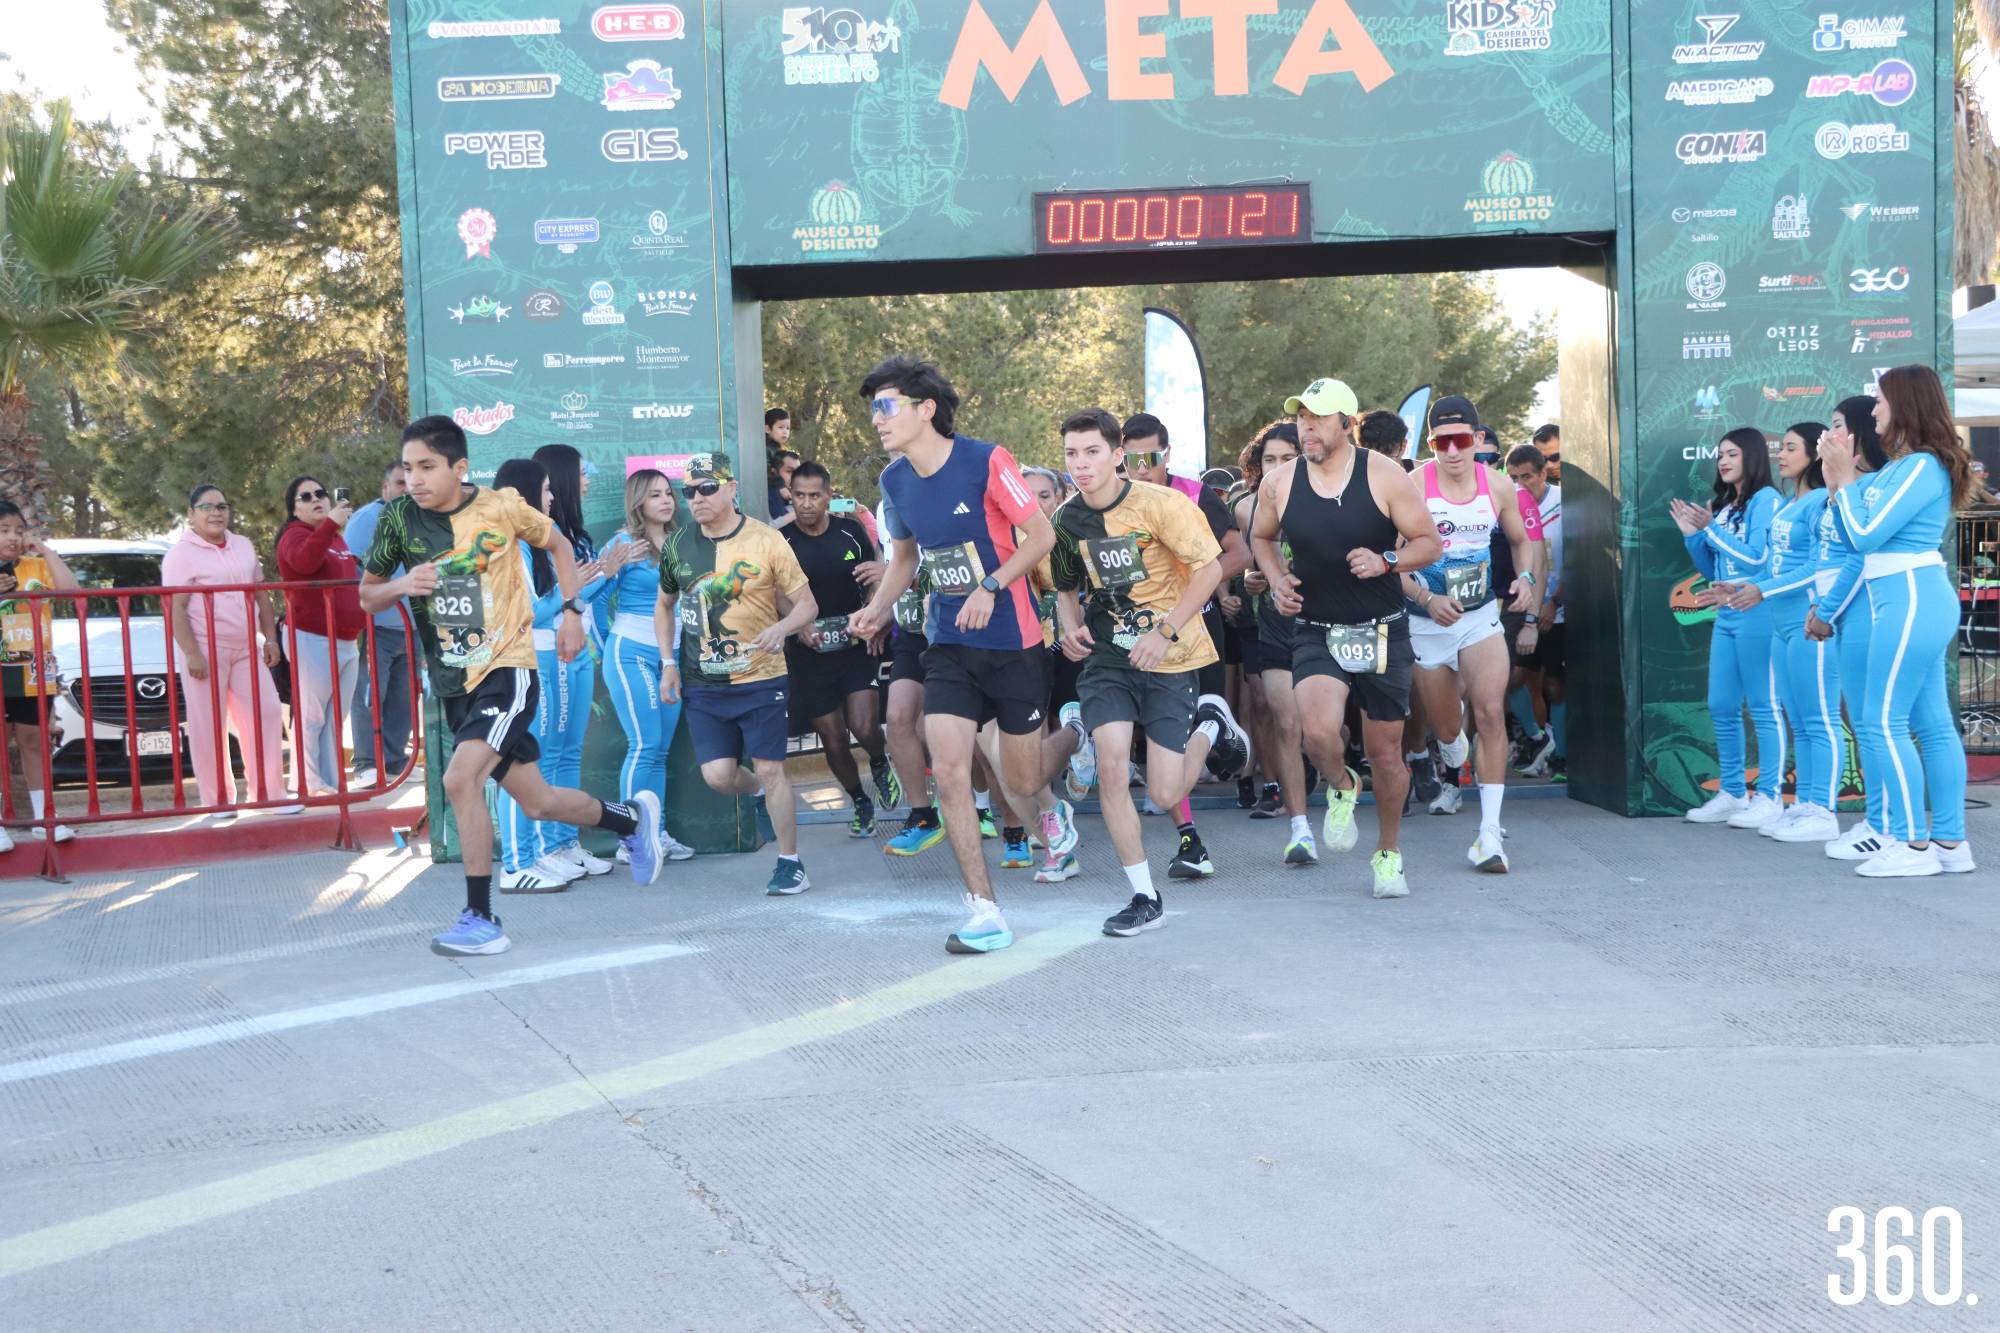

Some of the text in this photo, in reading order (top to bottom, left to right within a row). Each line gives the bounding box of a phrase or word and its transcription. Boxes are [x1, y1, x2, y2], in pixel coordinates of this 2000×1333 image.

[442, 22, 541, 36] VANGUARDIA
[1486, 29, 1547, 39] CARRERA DEL
[1486, 36, 1549, 49] DESIERTO
[937, 0, 1396, 111] META
[785, 65, 879, 84] DESIERTO
[471, 79, 550, 95] MODERNA
[447, 133, 542, 152] POWER
[1853, 134, 1908, 151] ROSEI
[1464, 194, 1554, 211] MUSEO DEL
[1473, 208, 1551, 223] DESIERTO
[539, 224, 595, 234] CITY EXPRESS
[792, 224, 881, 239] MUSEO DEL
[1773, 231, 1810, 239] SALTILLO
[802, 237, 878, 251] DESIERTO
[1691, 233, 1719, 242] Saltillo
[1758, 273, 1814, 287] SurtiPet
[638, 290, 697, 302] BLONDA
[583, 314, 623, 323] Western
[1766, 325, 1819, 339] ORTIZ
[1868, 330, 1912, 339] HIDALGO
[636, 345, 680, 354] Humberto
[1779, 339, 1820, 351] LEOS
[636, 355, 690, 364] Montemayor
[453, 401, 515, 427] Bokados
[1099, 548, 1133, 569] 906
[931, 565, 971, 586] 1380
[434, 595, 473, 616] 826
[1331, 643, 1375, 661] 1093
